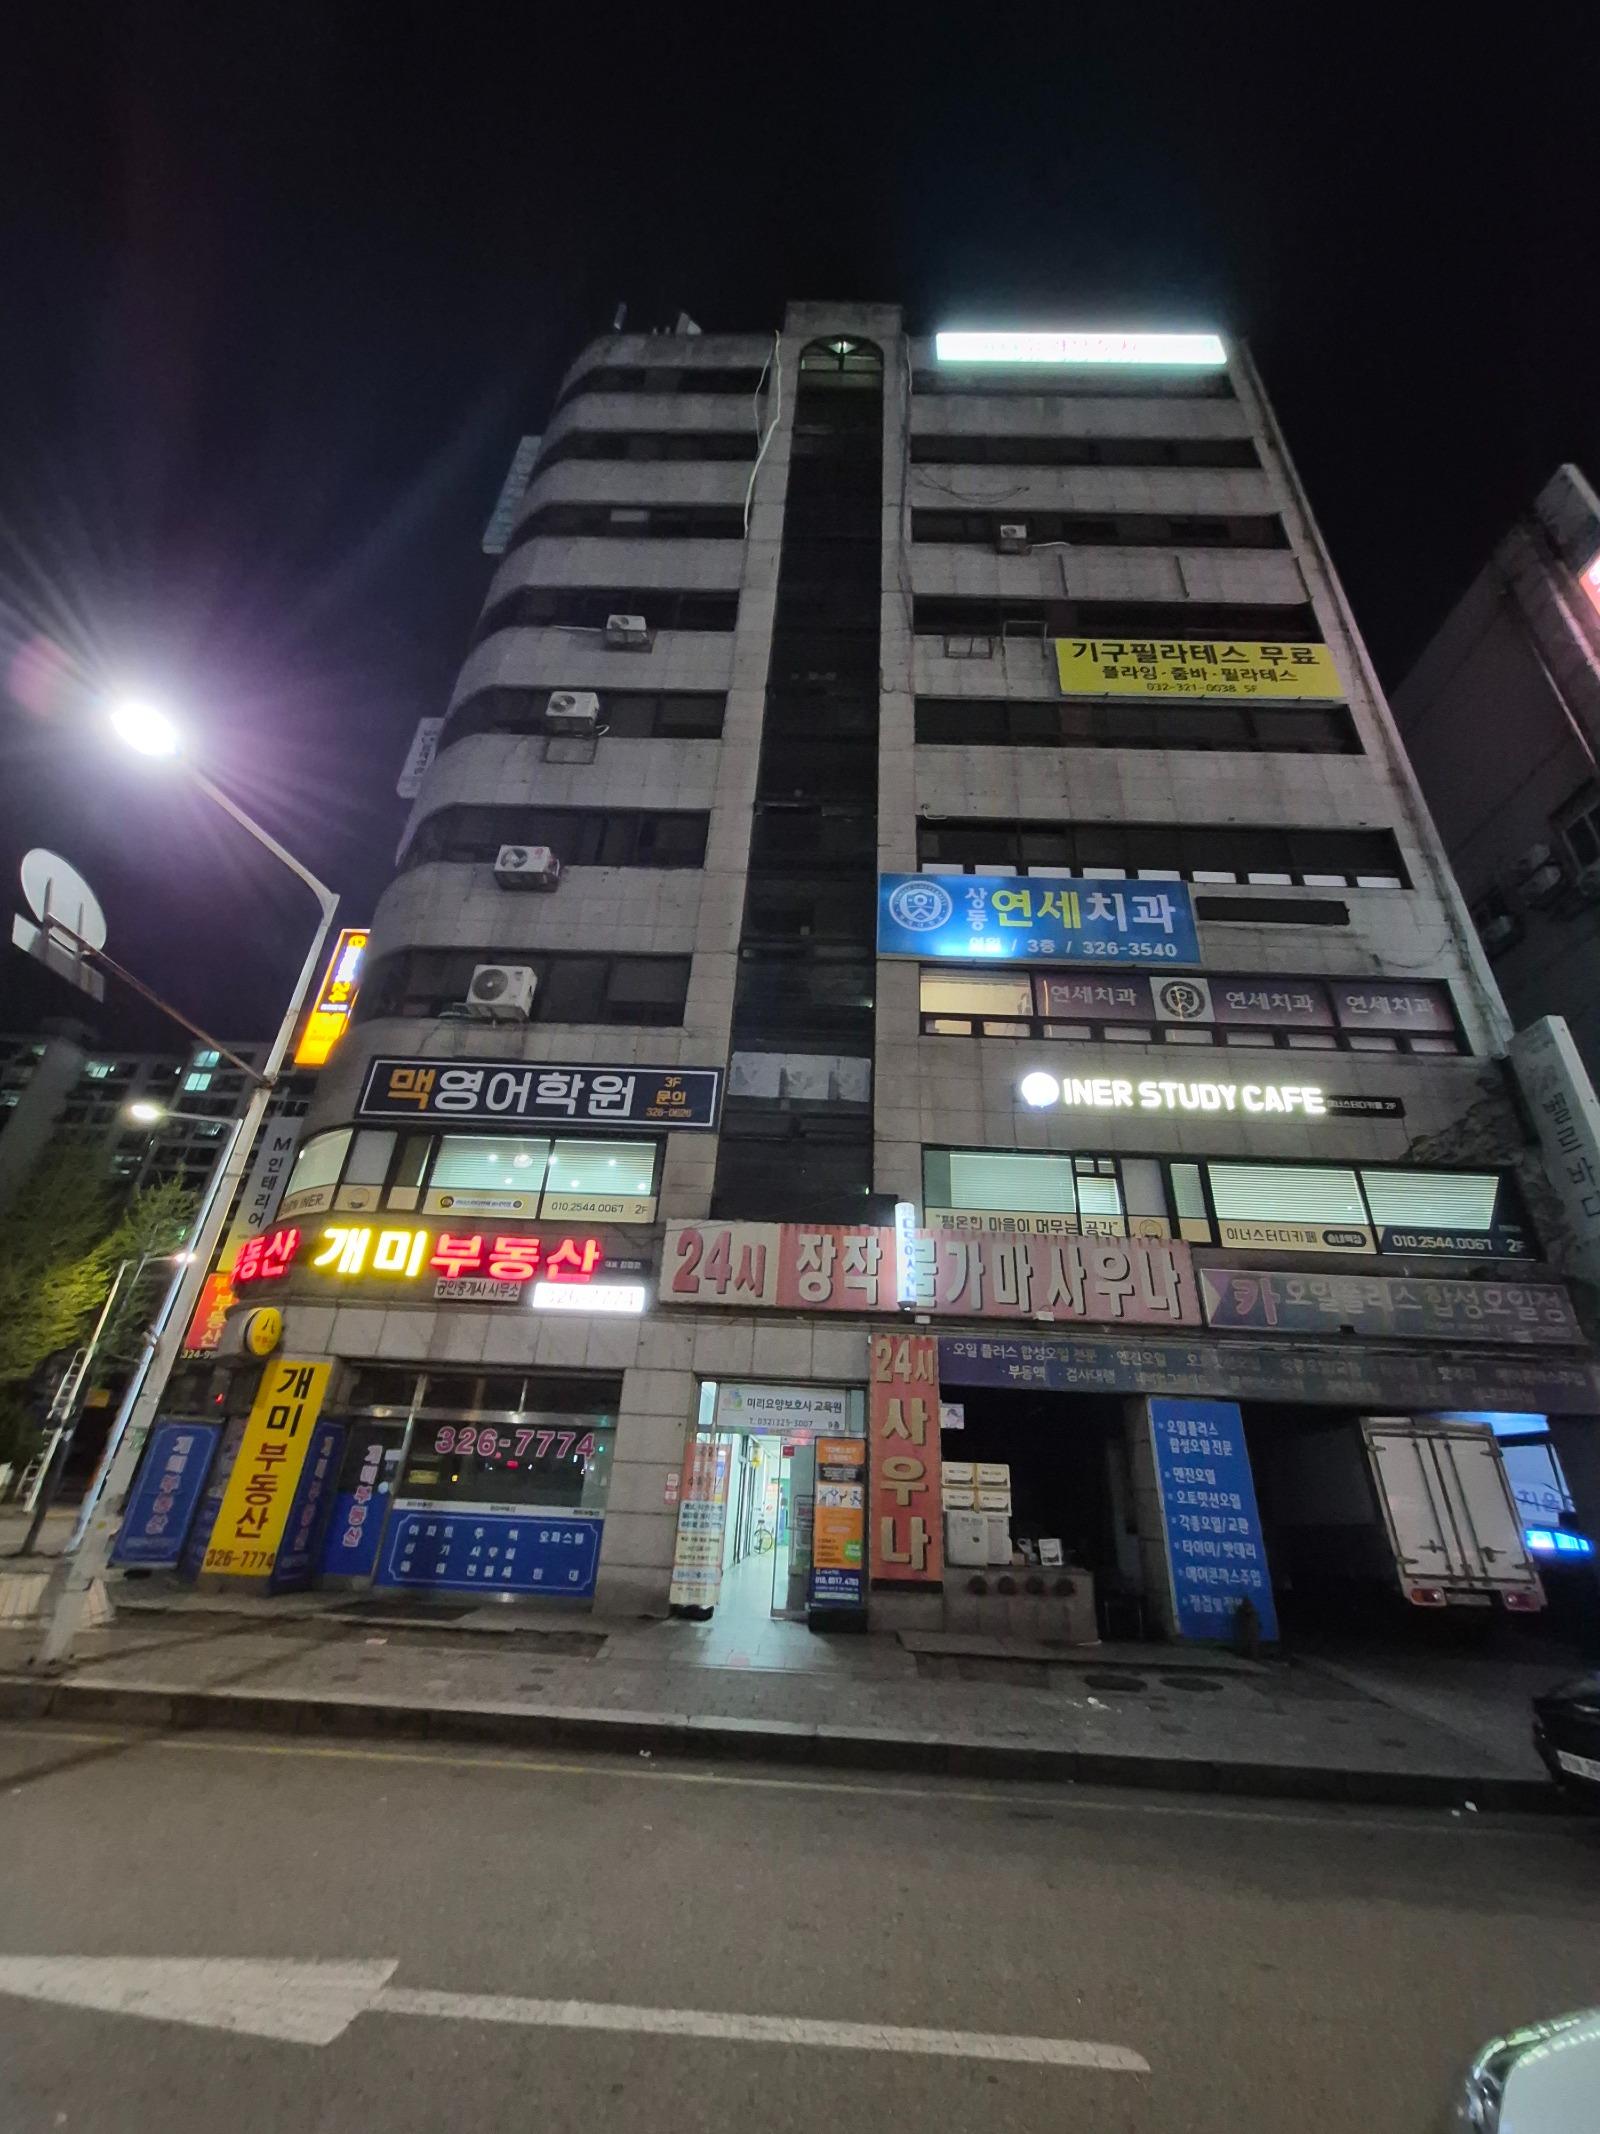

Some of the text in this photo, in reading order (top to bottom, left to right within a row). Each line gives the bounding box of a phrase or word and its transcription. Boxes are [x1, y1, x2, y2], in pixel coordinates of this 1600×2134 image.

[1072, 642, 1320, 665] 기구필라테스 무료
[1102, 665, 1298, 682] 플라잉 줌바 필라테스
[965, 887, 990, 931] 상동
[991, 889, 1177, 934] 연세치과
[1027, 939, 1057, 953] 3층
[1083, 940, 1178, 958] 326-3540
[1050, 985, 1137, 1006] 연세치과
[1225, 991, 1314, 1012] 연세치과
[1346, 993, 1434, 1015] 연세치과
[664, 1076, 682, 1088] 3F
[387, 1068, 635, 1118] 맥영어학원
[656, 1090, 687, 1105] 문의
[1063, 1078, 1327, 1115] INER STUDY CAFE
[634, 1203, 648, 1214] 2F
[988, 1216, 1030, 1232] 마음이
[1036, 1218, 1079, 1234] 머무는
[1226, 1228, 1317, 1243] 이너스터디카페
[1391, 1235, 1525, 1253] 010.2544.0067 2F
[315, 1227, 599, 1283] 개미부동산
[671, 1227, 766, 1299] 24시
[1047, 1243, 1182, 1320] 사우나
[437, 1280, 518, 1298] 공인중개사 사무소
[1230, 1276, 1281, 1326] 카
[875, 1339, 935, 1385] 24시
[746, 1397, 842, 1414] 미리요양보호사 교육원
[1167, 1420, 1219, 1436] 오일플러스
[434, 1425, 596, 1459] 326-7774
[235, 1367, 315, 1539] 개미부동산
[881, 1397, 932, 1571] 사우나
[1172, 1467, 1216, 1485] 엔진오일
[205, 1548, 275, 1568] 326-7774
